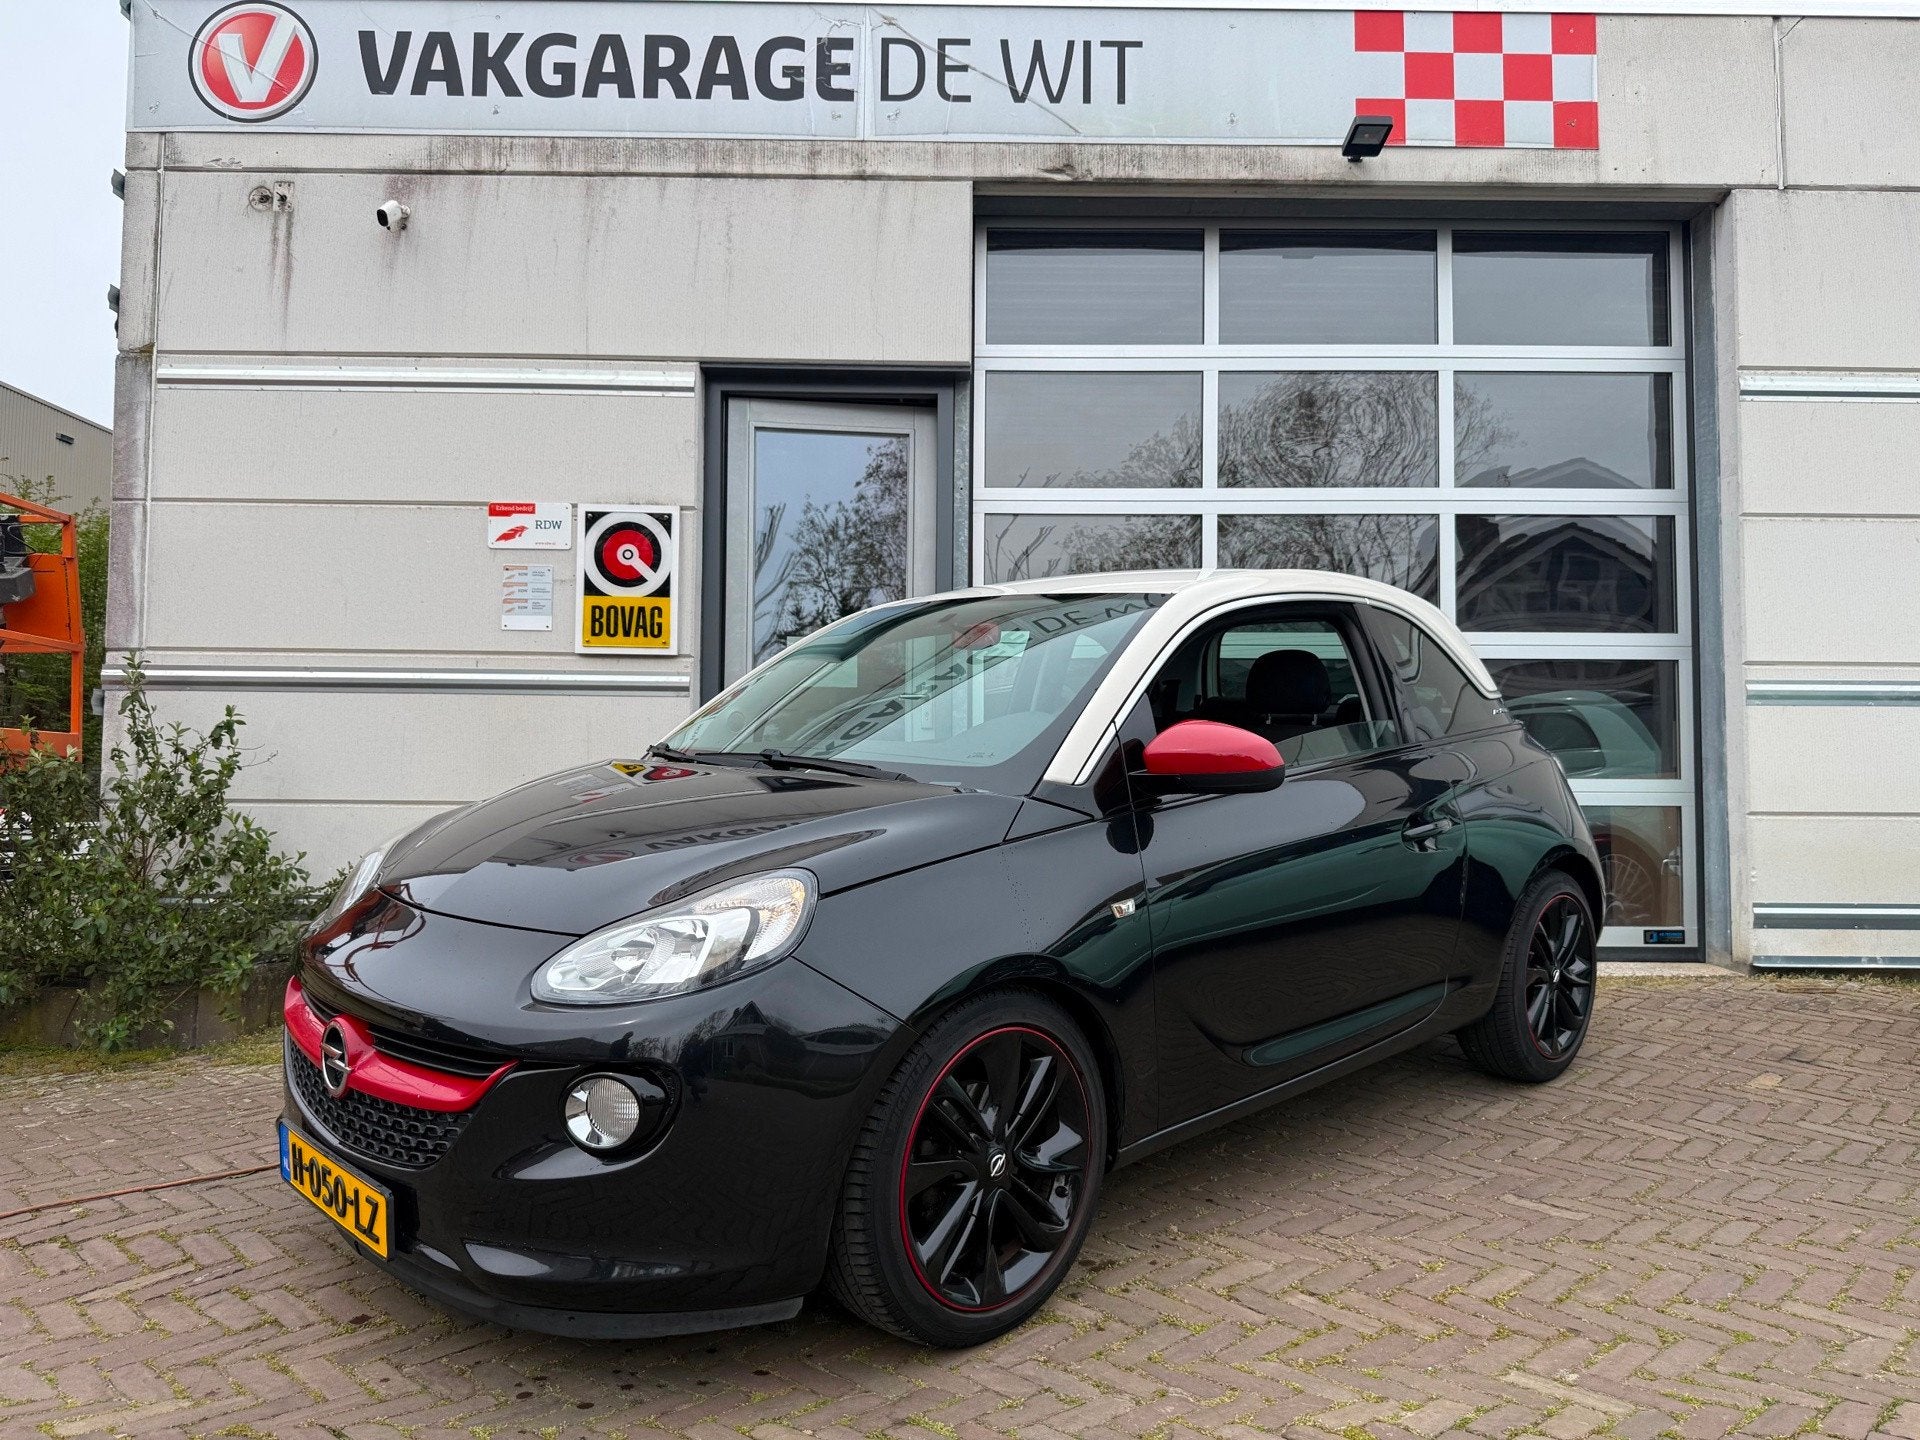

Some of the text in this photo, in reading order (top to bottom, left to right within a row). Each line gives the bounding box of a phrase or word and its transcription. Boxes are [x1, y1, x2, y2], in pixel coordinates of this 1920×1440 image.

[358, 30, 1143, 105] VAKGARAGE DE WIT
[535, 520, 563, 530] RDW
[590, 605, 663, 639] BOVAG
[291, 1142, 380, 1245] H-050-LZ
